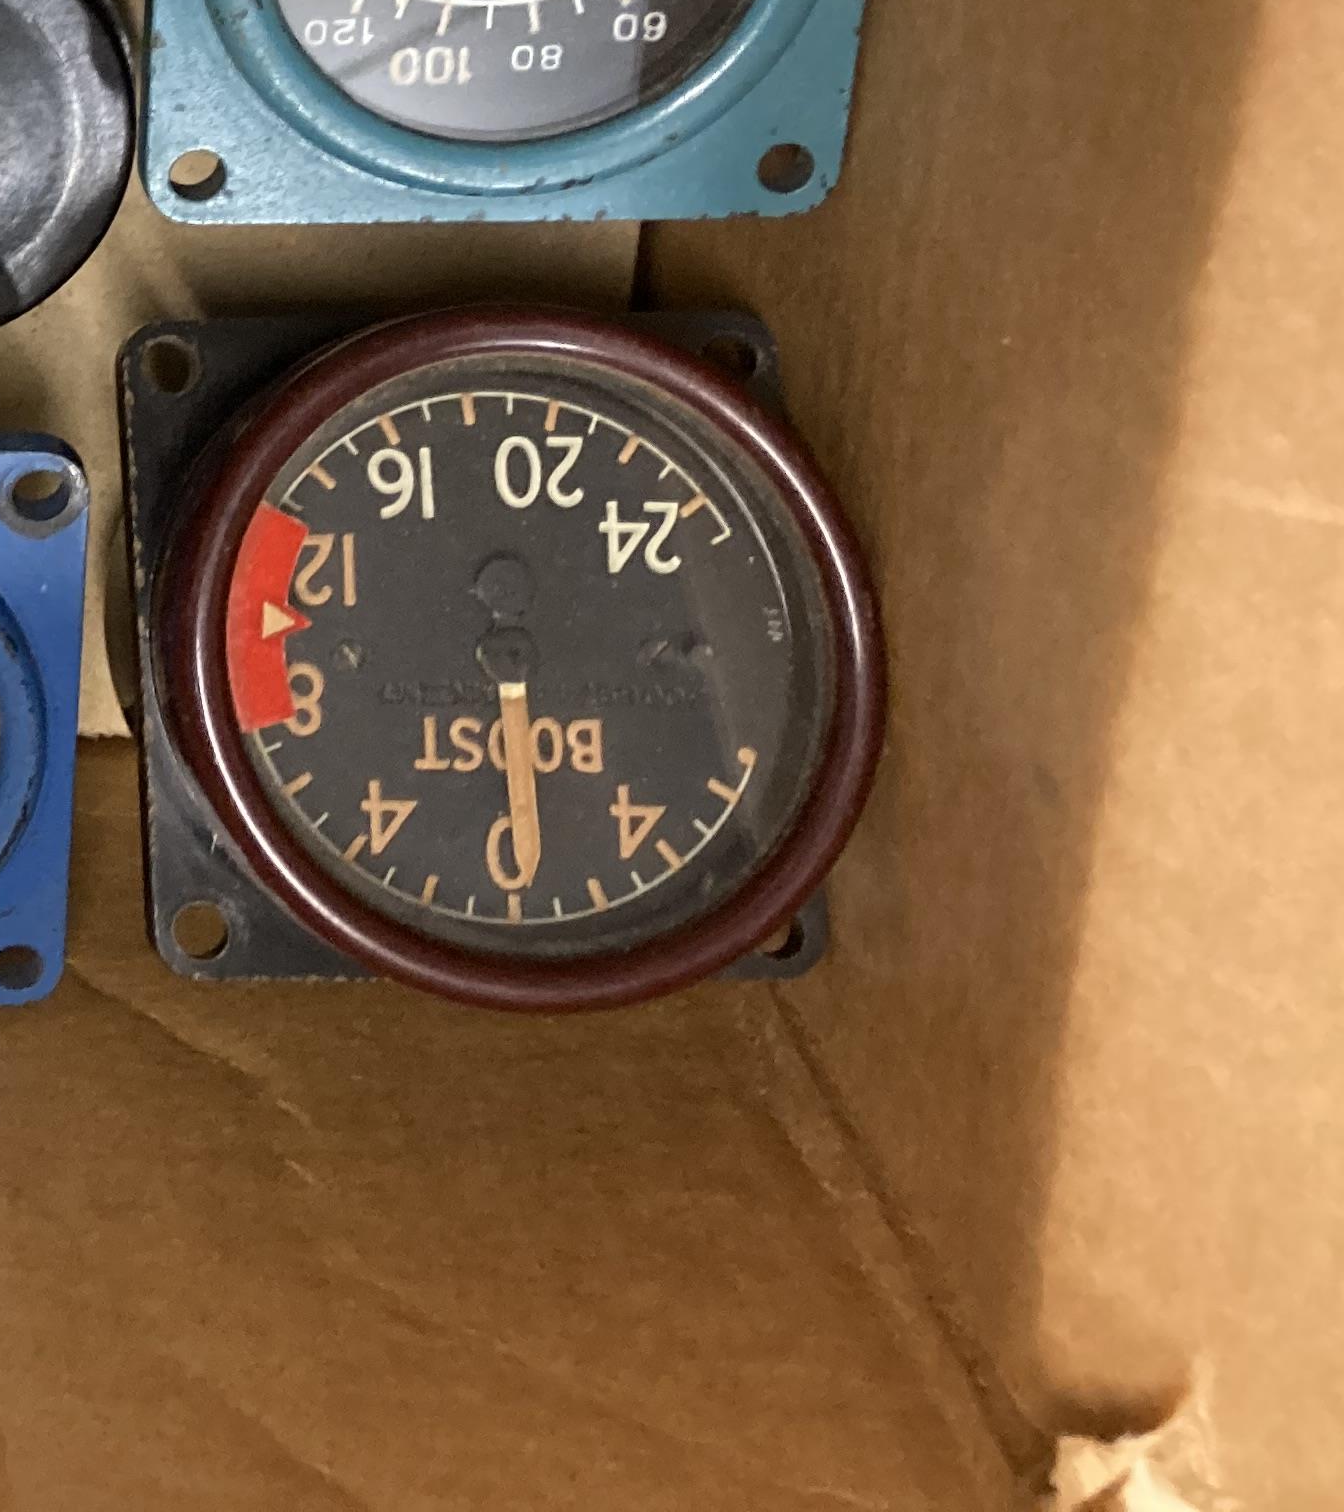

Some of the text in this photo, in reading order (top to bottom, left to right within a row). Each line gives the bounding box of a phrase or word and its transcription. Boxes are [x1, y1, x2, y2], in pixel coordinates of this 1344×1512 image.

[304, 17, 374, 46] 120
[512, 44, 564, 71] 80
[613, 12, 668, 41] 60
[390, 46, 471, 86] 100
[366, 446, 434, 519] 16
[494, 435, 585, 508] 20
[294, 532, 357, 607] 12
[598, 501, 682, 574] 24
[414, 715, 604, 773] BOOST
[361, 779, 417, 856] 4
[609, 784, 667, 859] 4
